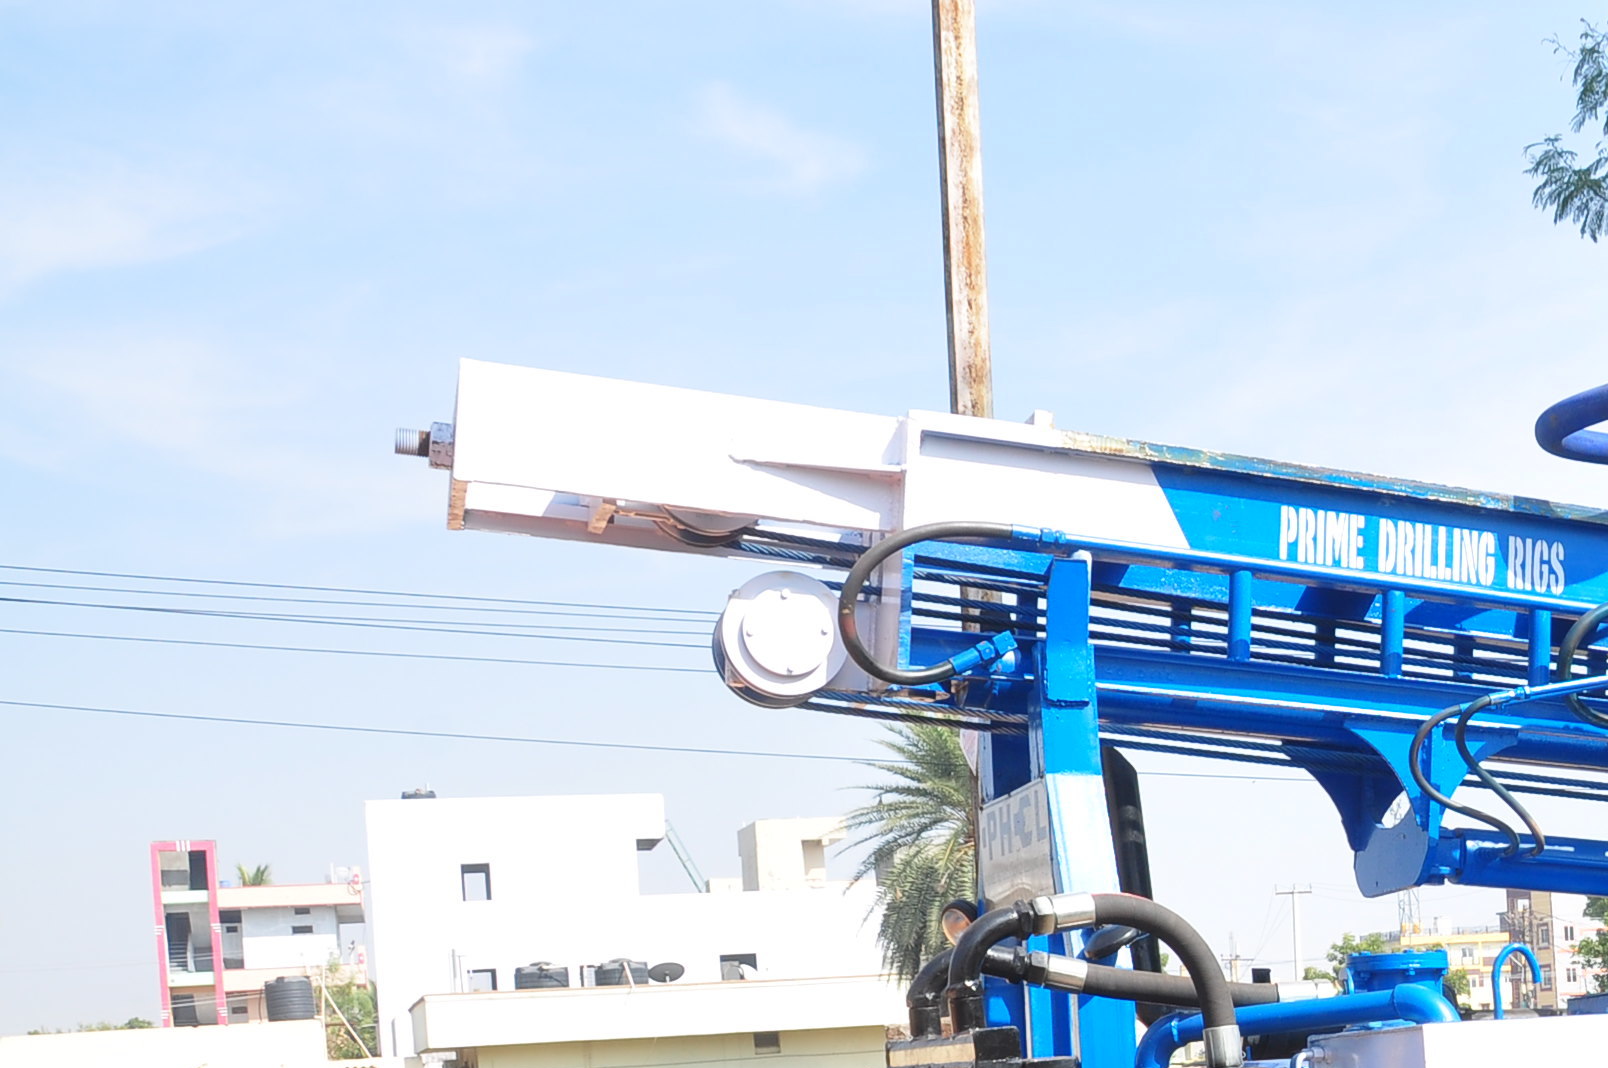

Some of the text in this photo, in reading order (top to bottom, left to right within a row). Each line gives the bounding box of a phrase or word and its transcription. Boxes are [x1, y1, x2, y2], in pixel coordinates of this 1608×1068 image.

[1279, 505, 1565, 596] PRIME DRILLING RIGS
